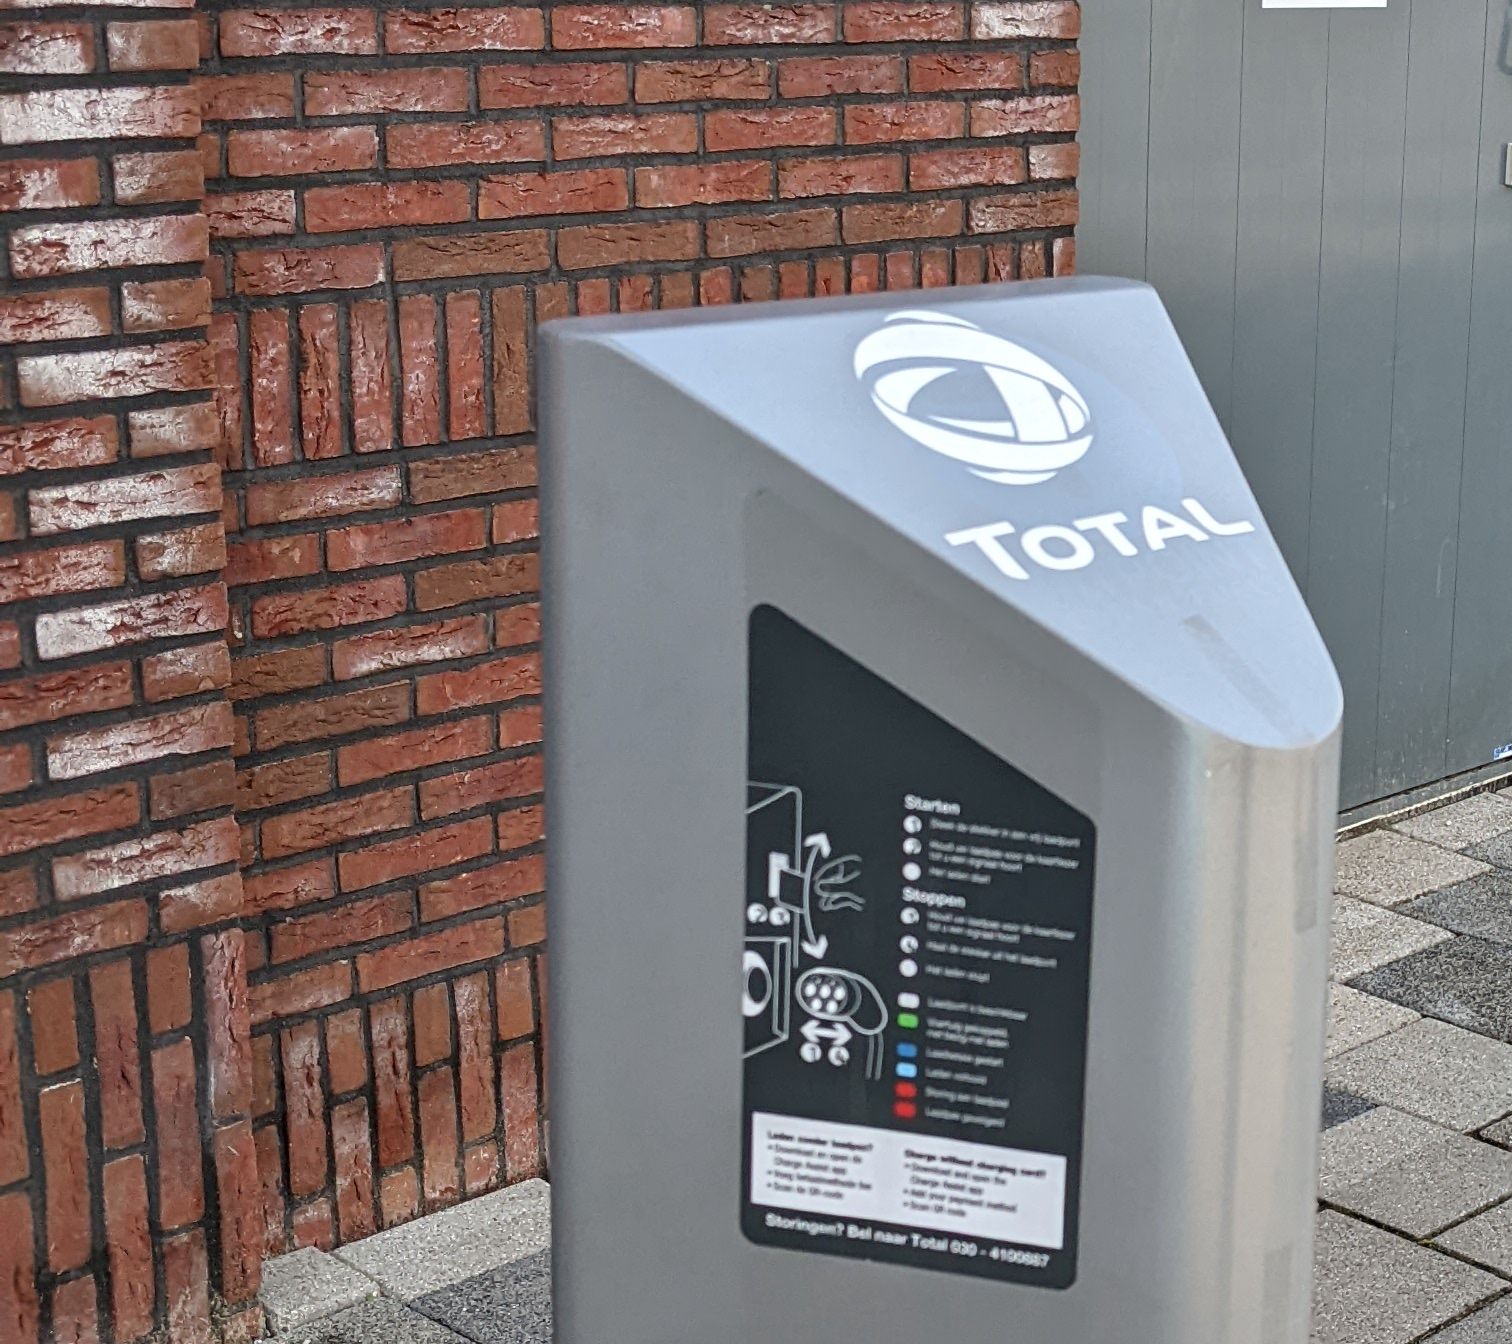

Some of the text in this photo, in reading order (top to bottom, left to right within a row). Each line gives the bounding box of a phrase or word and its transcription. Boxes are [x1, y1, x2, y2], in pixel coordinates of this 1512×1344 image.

[904, 794, 961, 816] Starten
[903, 886, 966, 909] Stoppen
[765, 1212, 845, 1236] Storingen?
[847, 1224, 872, 1240] Bel
[873, 1230, 907, 1245] naar
[910, 1232, 948, 1251] Total
